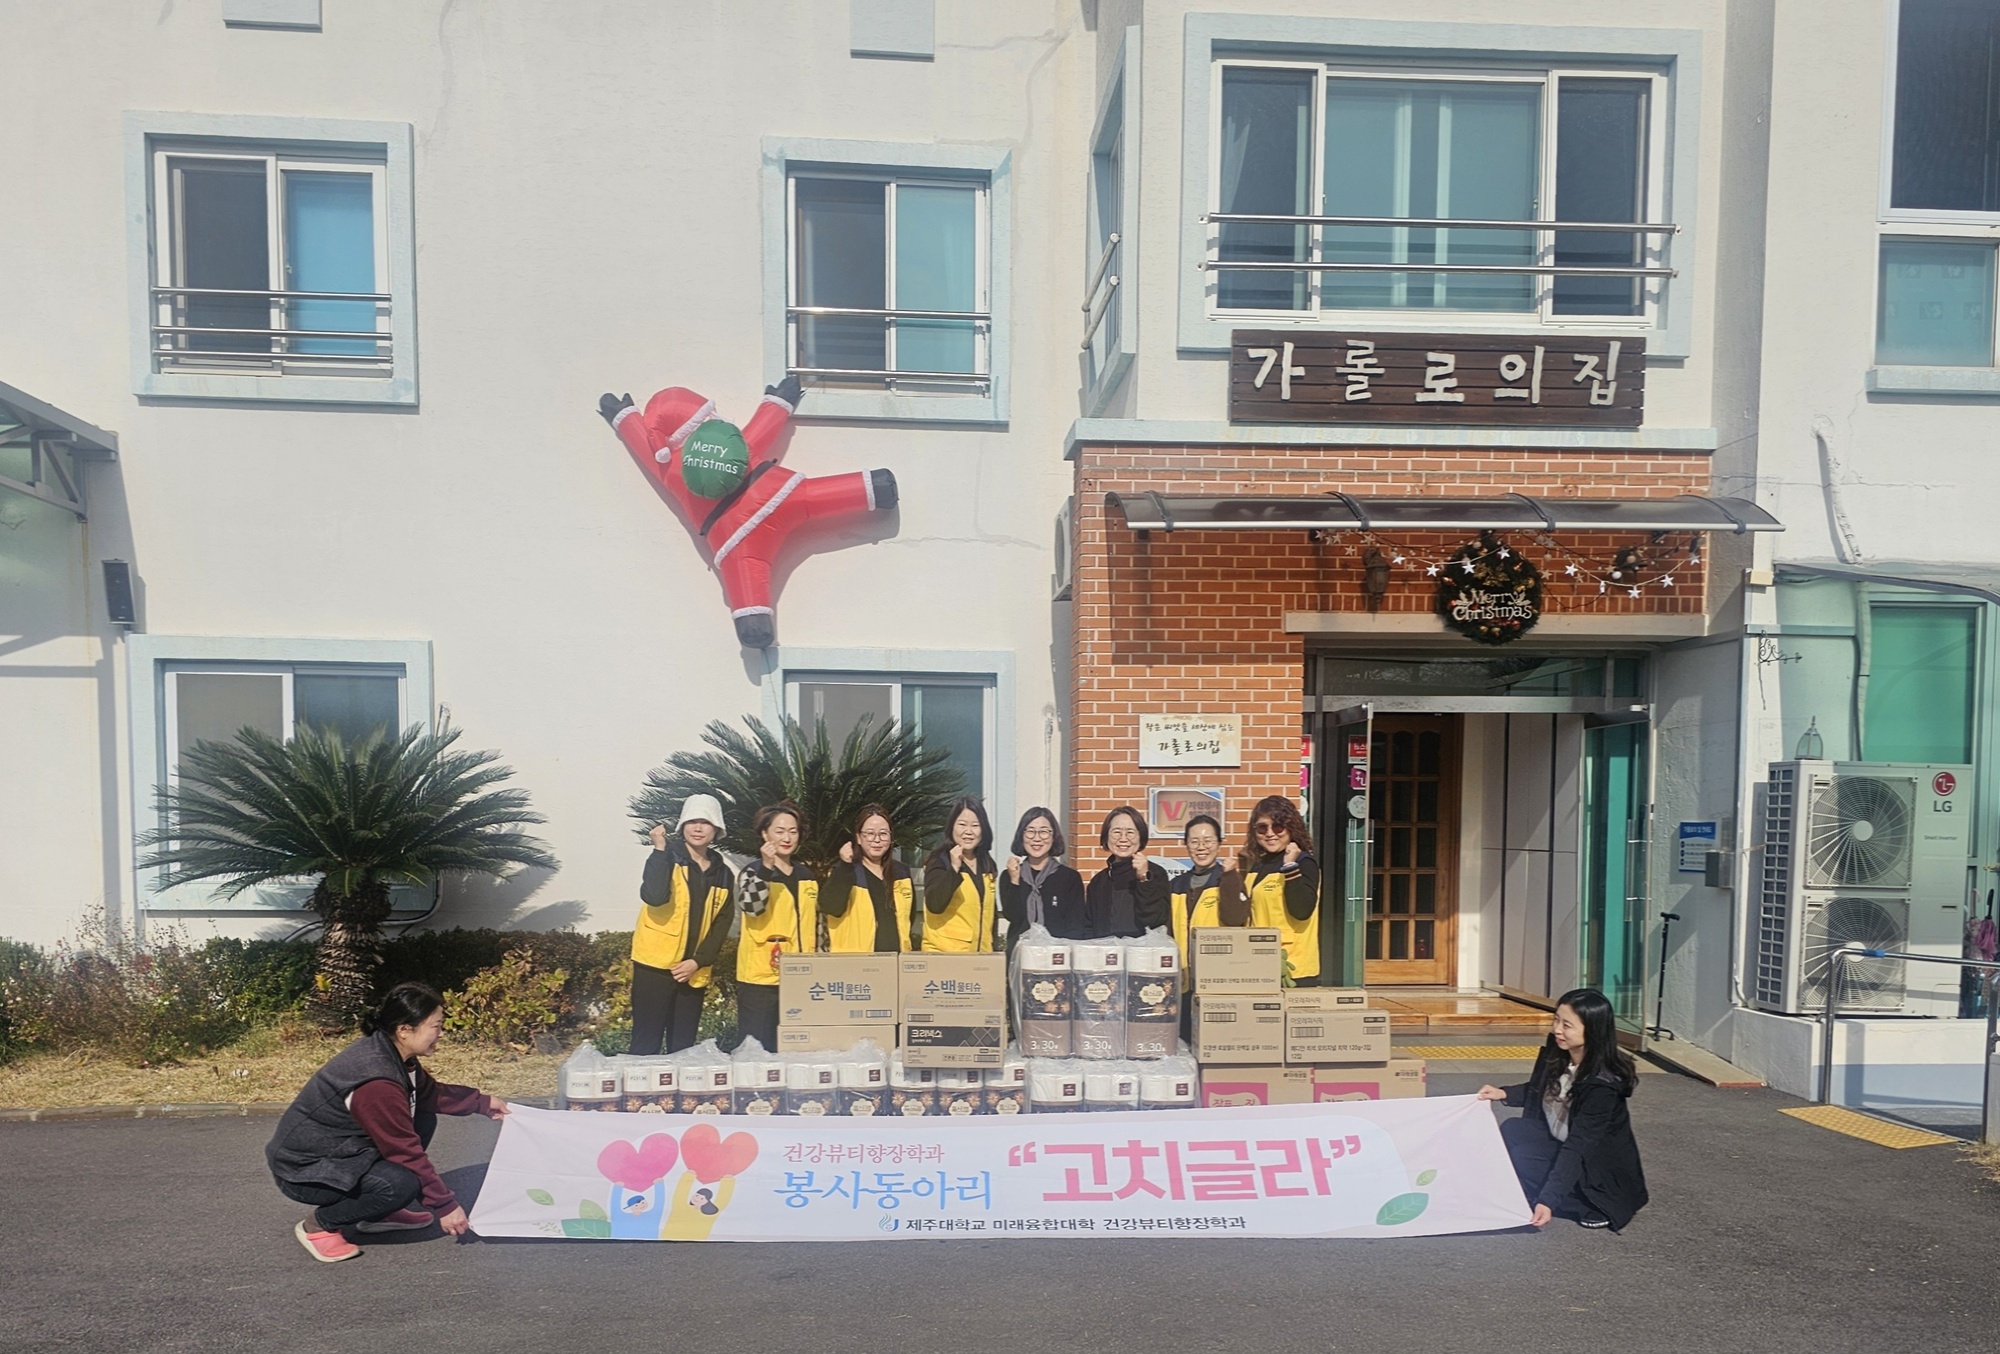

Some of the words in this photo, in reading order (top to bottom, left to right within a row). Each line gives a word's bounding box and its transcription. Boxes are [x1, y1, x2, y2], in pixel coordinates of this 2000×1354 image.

[691, 441, 728, 458] Merry
[683, 454, 738, 474] Christmas
[1470, 588, 1519, 605] Merry
[1453, 605, 1532, 622] Christmas
[1933, 800, 1952, 813] LG
[808, 981, 844, 1001] 순백
[845, 983, 871, 993] 물티슈
[957, 982, 982, 993] 물티슈
[911, 1029, 942, 1038] 크리넥스
[783, 1142, 945, 1164] 건강뷰티향장학과
[773, 1170, 992, 1210] 봉사동아리
[906, 1218, 986, 1232] 제주대학교
[993, 1217, 1095, 1232] 미래융합대학
[1103, 1216, 1246, 1231] 건강뷰티향장학과
